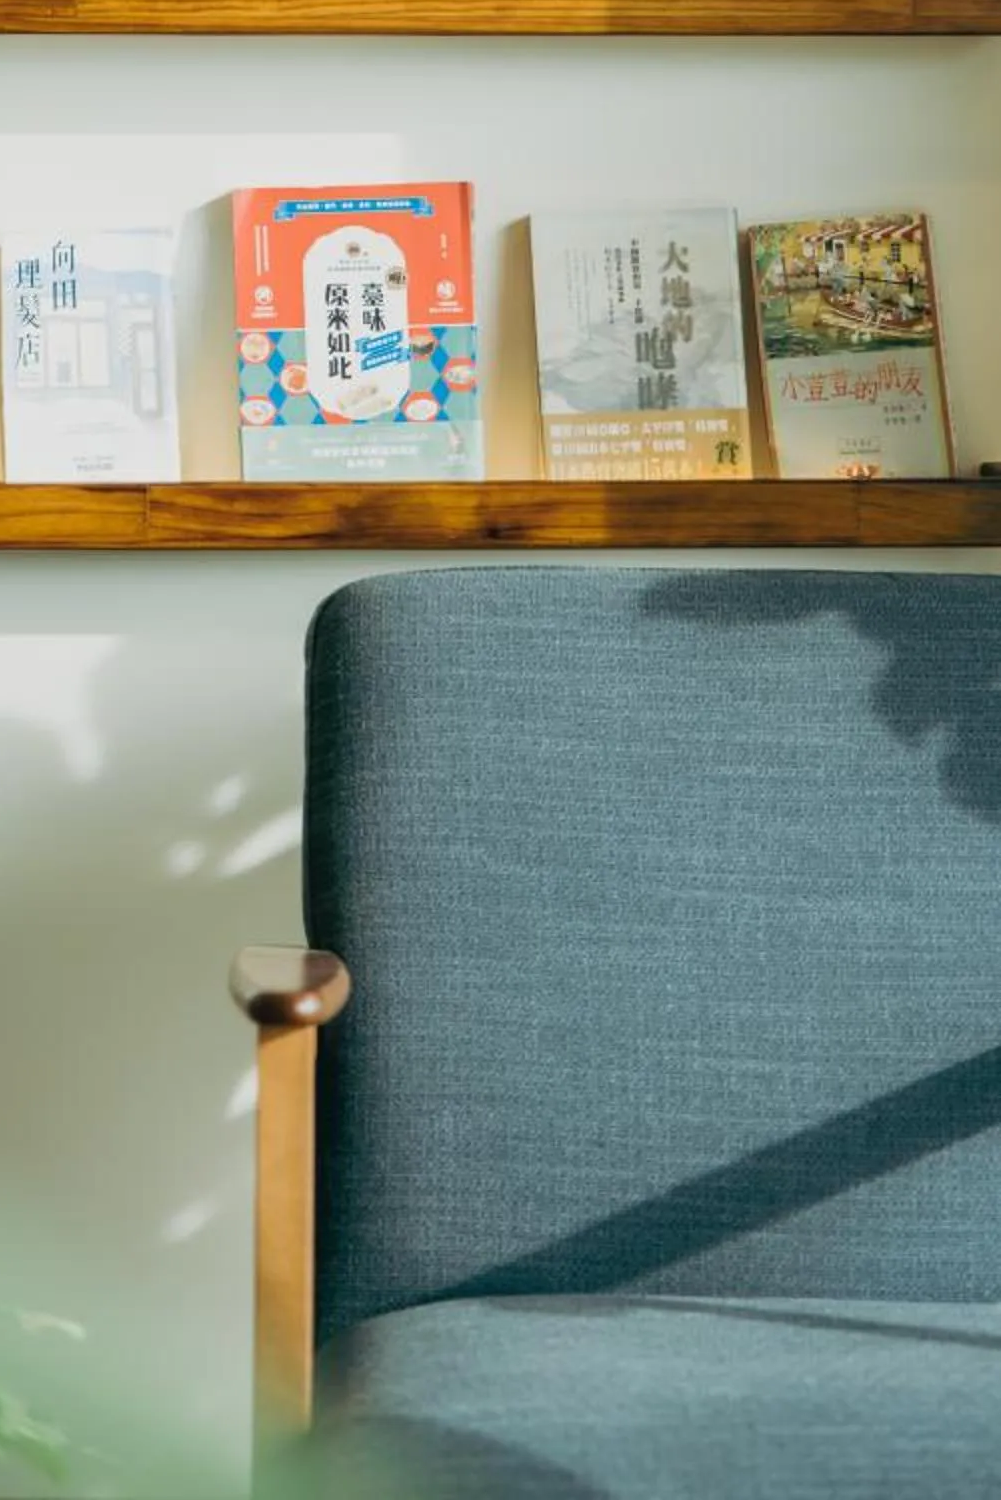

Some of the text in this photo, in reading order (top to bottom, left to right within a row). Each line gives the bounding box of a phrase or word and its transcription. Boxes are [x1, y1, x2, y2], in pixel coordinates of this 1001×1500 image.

[51, 239, 78, 311] 向田
[324, 283, 352, 380] 原來如此
